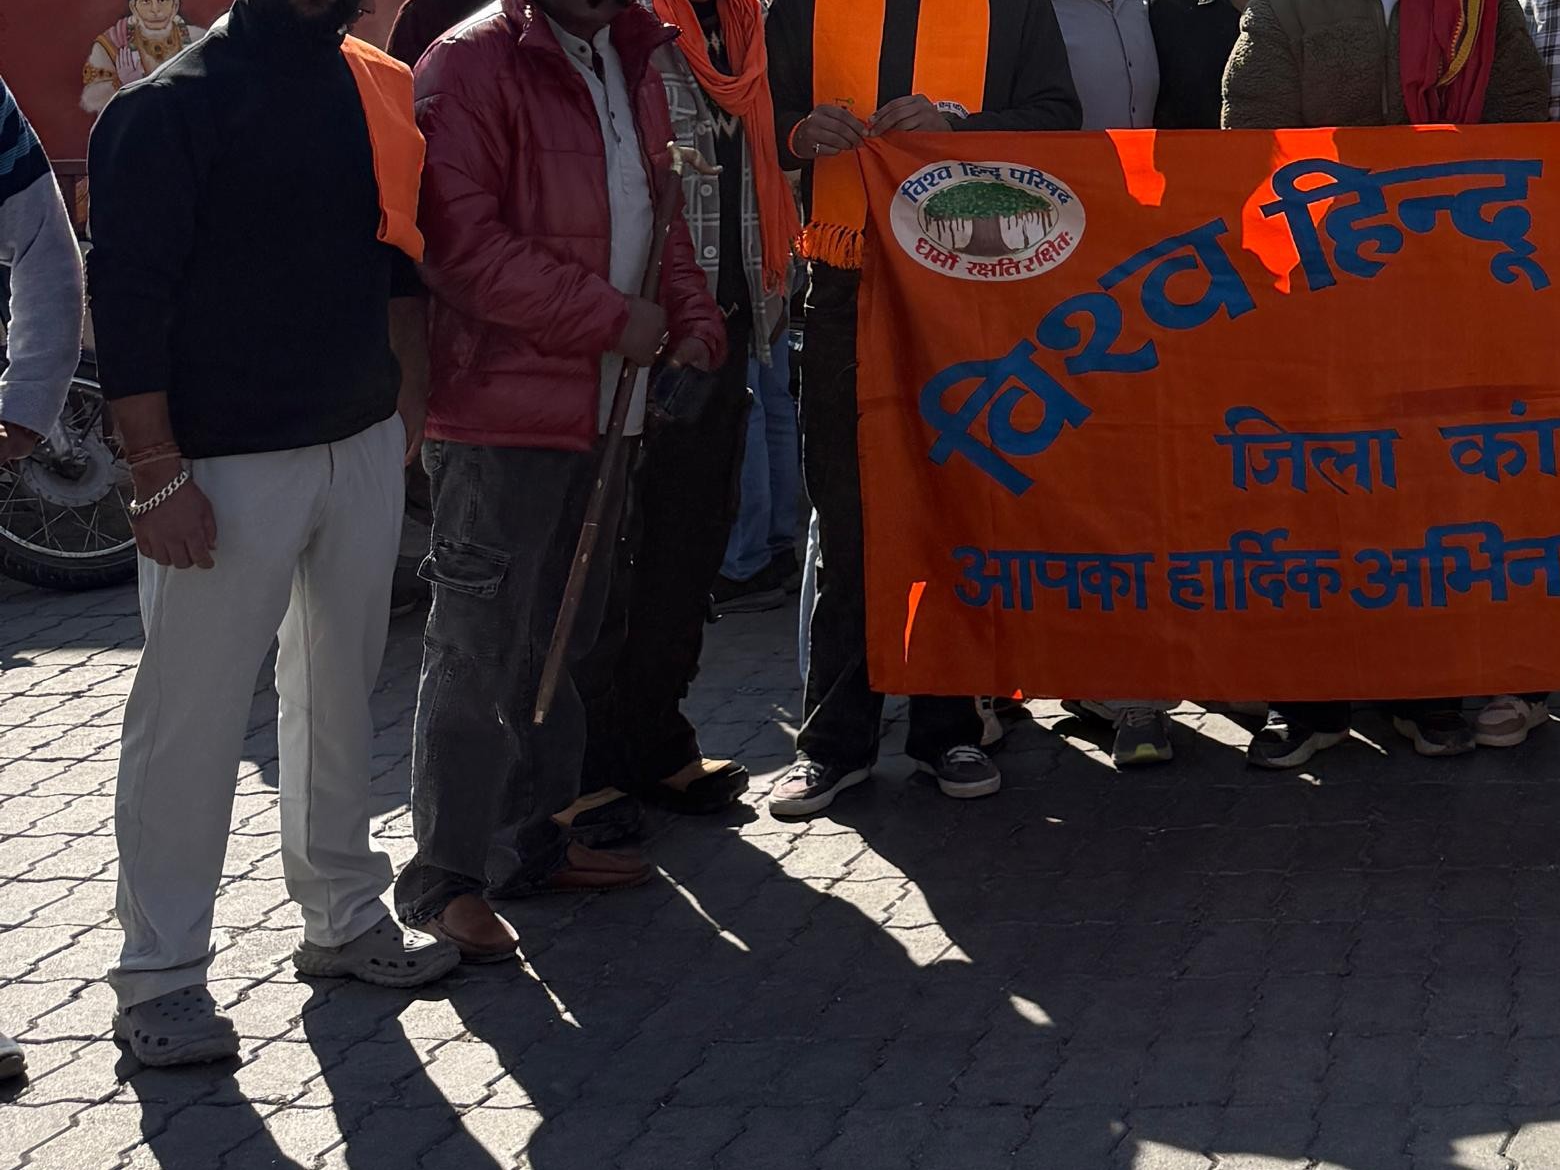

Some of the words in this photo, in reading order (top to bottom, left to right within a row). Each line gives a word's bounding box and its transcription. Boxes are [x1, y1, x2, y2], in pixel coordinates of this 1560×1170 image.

[901, 165, 952, 204] विश्व
[958, 162, 1006, 182] हिन्दू
[1009, 166, 1074, 205] परिषद
[966, 257, 1021, 278] रक्षति
[918, 217, 1257, 497] विश्व
[1259, 158, 1551, 292] हिन्दू
[1214, 405, 1402, 494] जिला
[952, 546, 1155, 612] आपका
[1168, 528, 1342, 611] हार्दिक
